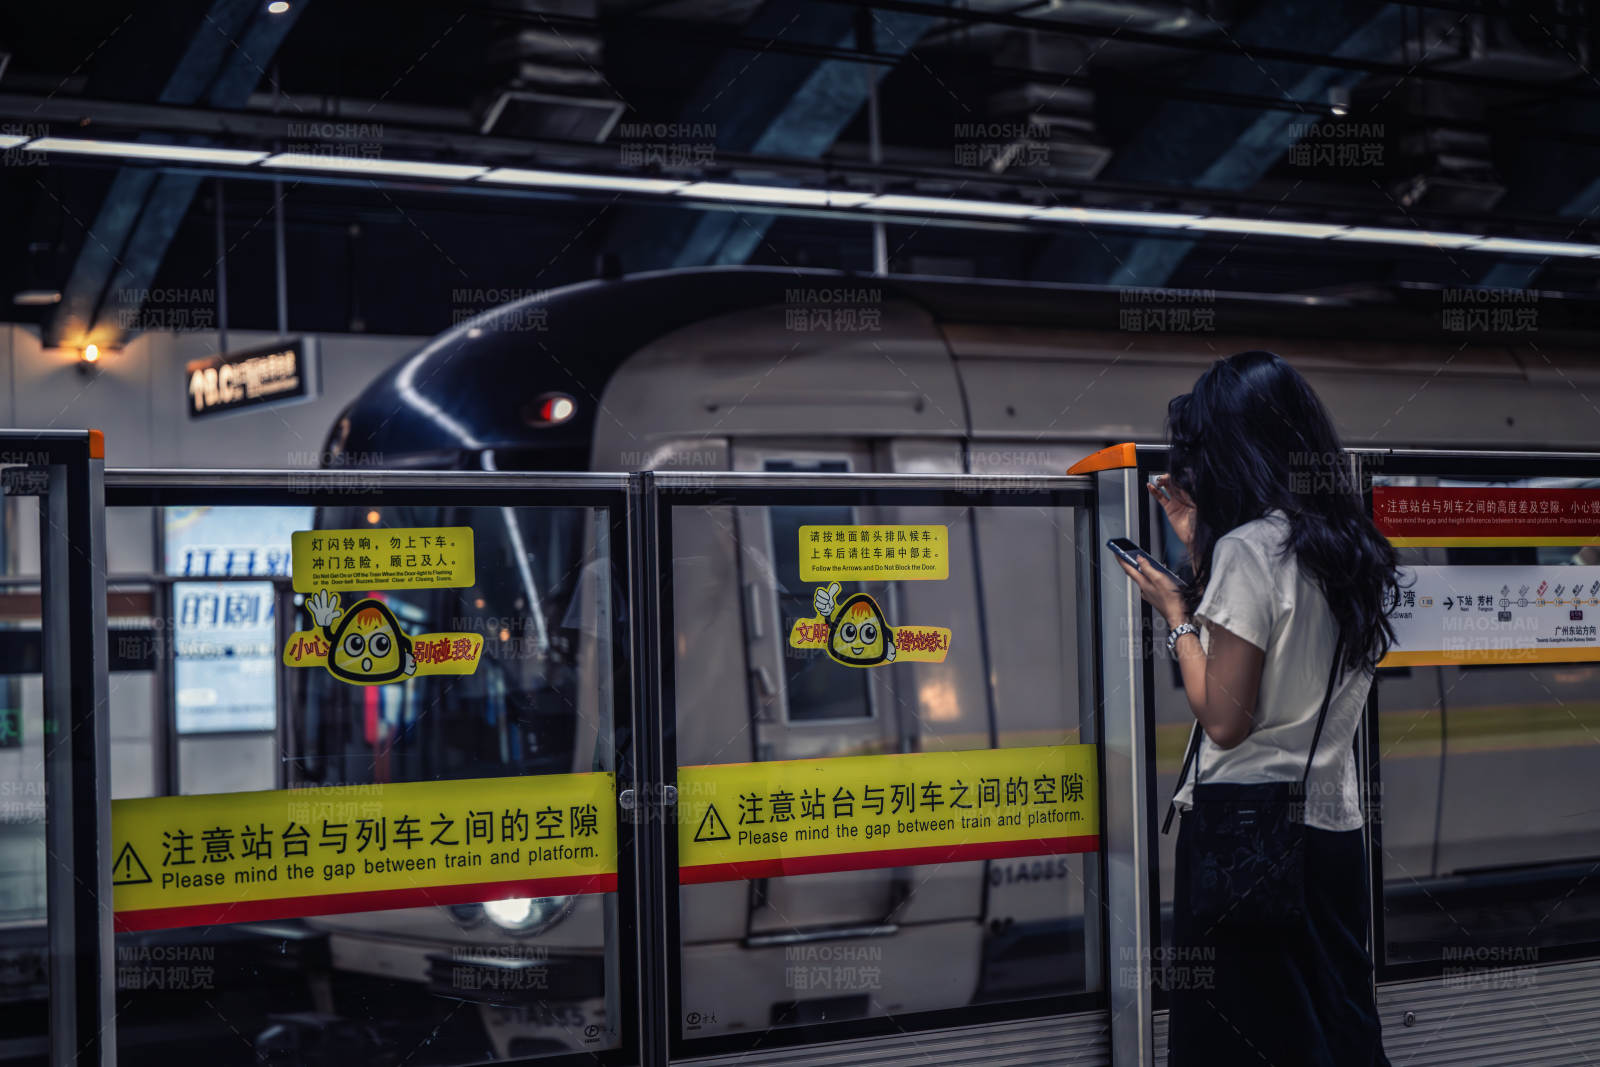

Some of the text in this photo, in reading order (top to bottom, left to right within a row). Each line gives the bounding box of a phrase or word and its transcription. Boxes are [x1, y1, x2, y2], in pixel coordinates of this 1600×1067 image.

[810, 530, 938, 542] 请按地面箭头排队候车。
[312, 554, 456, 570] 冲门危险，顾己及人。
[810, 547, 938, 559] 上车后请往车厢中部走。
[1457, 595, 1472, 606] 下站
[1478, 595, 1493, 606] 芳村
[796, 622, 829, 645] 文明
[1554, 626, 1596, 636] 广州东站方向
[290, 635, 329, 661] 小心
[738, 772, 1086, 827] 注意站台与列车之间的空隙
[162, 803, 600, 867] 注意站台与列车之间的空隙
[738, 808, 1085, 846] Please mind the gap between train and platform.
[162, 842, 600, 890] Please mind the gap between train and platform.
